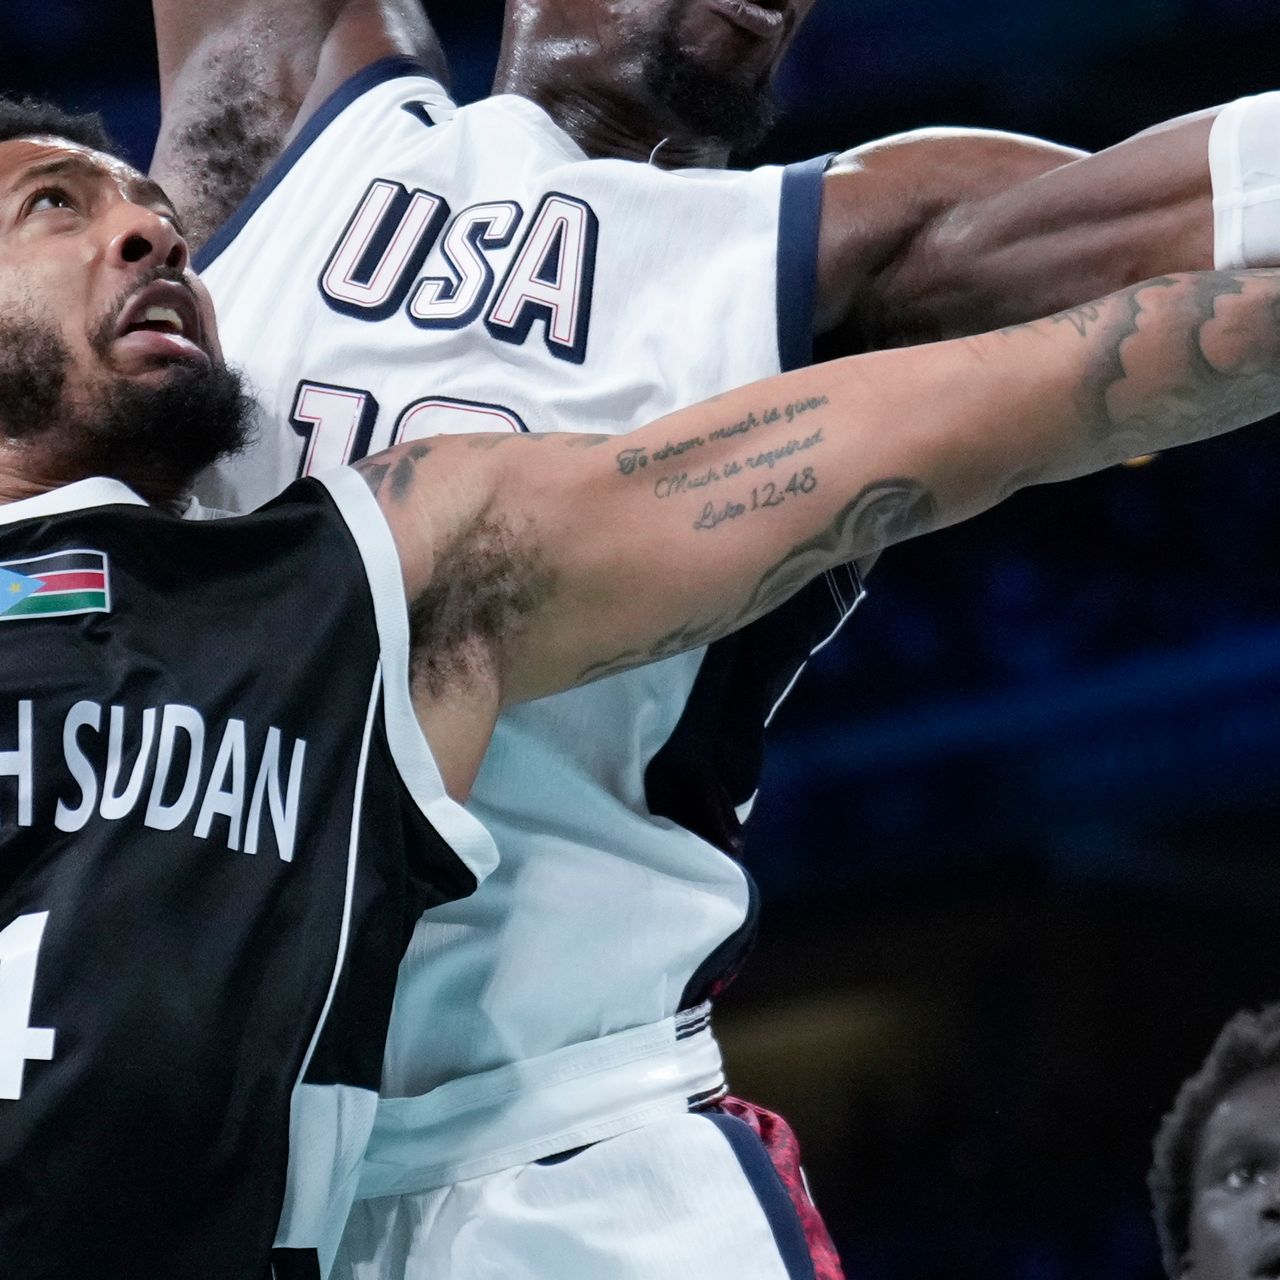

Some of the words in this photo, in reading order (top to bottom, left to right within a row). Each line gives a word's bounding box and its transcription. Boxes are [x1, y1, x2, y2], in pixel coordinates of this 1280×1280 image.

[318, 177, 599, 364] USA
[289, 379, 529, 477] 1
[616, 448, 648, 475] To
[709, 412, 760, 441] much
[763, 406, 781, 422] is
[784, 394, 829, 422] given
[654, 470, 721, 500] Much
[723, 462, 742, 477] is
[746, 428, 824, 469] required
[693, 499, 746, 531] Luke
[751, 466, 818, 511] 12:48
[54, 701, 306, 862] SUDAN
